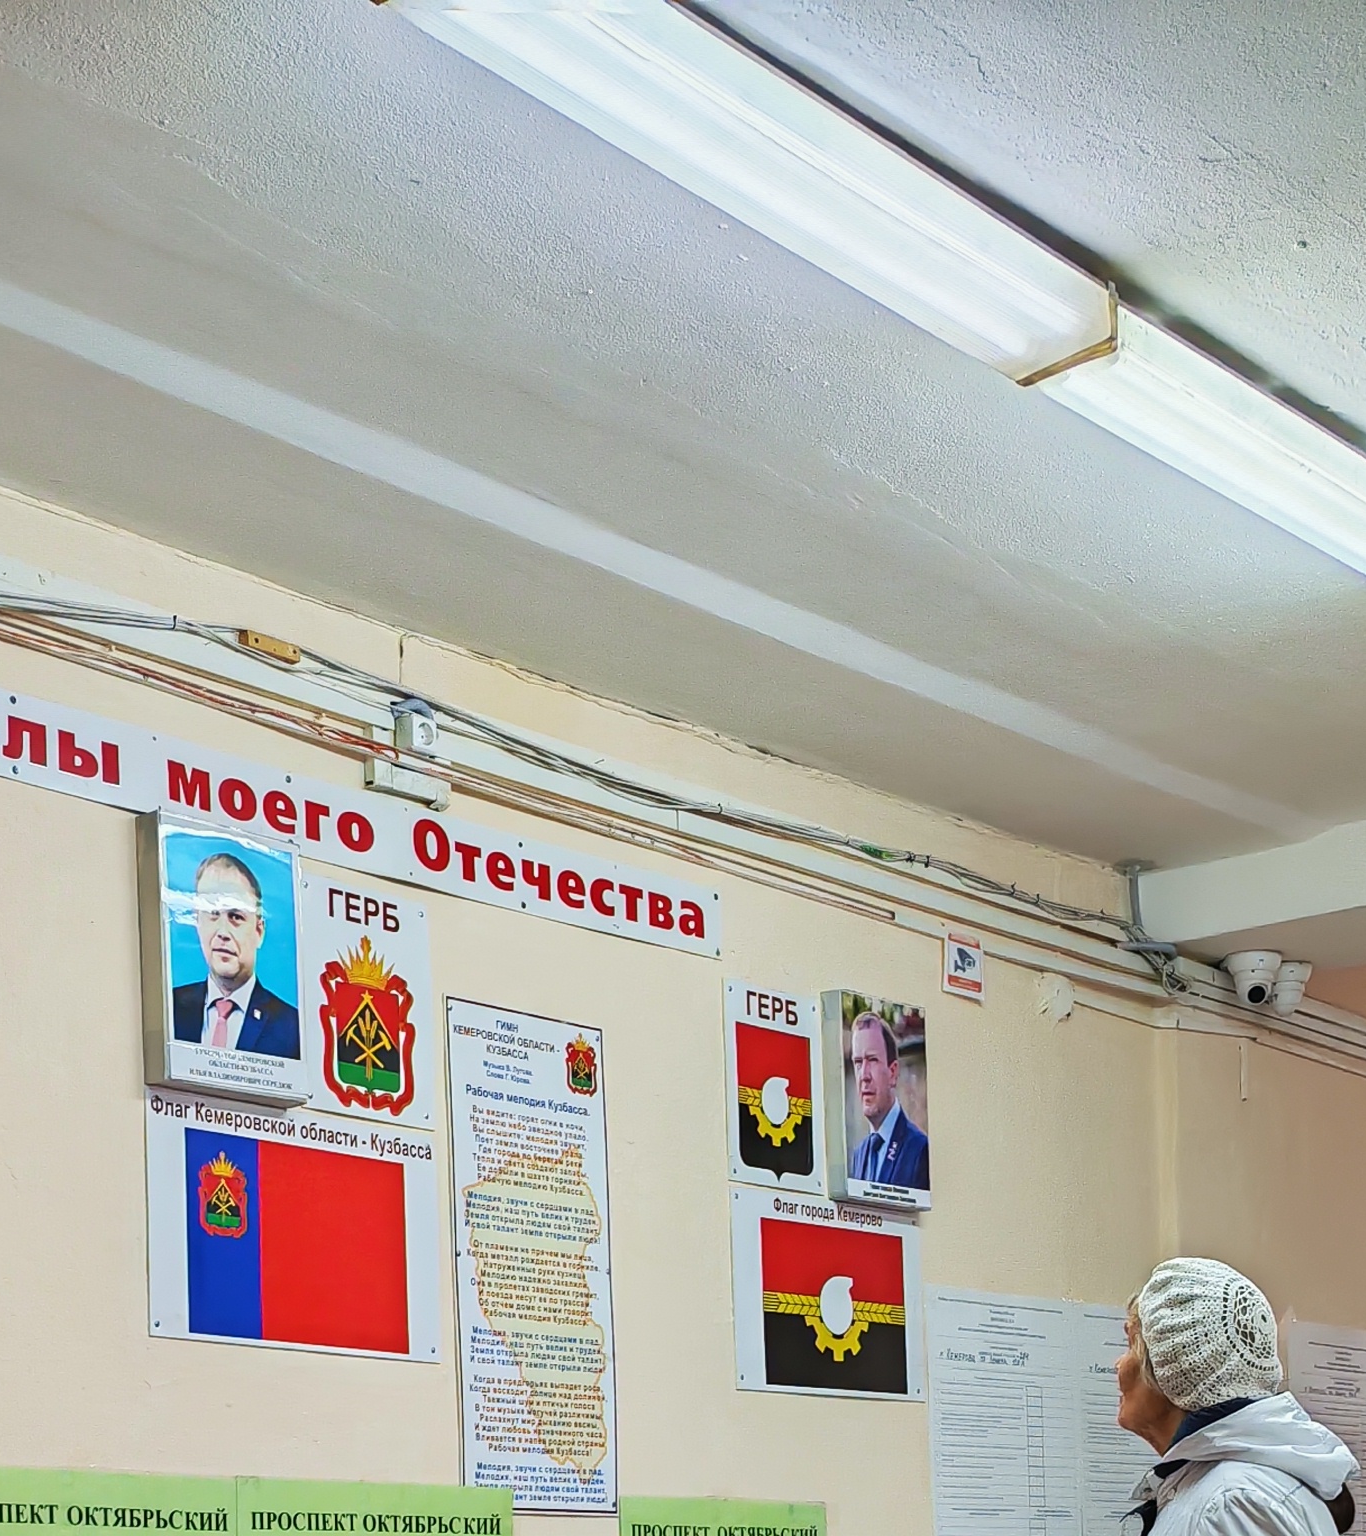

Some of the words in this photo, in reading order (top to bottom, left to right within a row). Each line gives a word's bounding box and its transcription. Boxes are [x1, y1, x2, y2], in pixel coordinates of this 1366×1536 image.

[167, 759, 375, 853] моего
[412, 819, 706, 939] Отечества
[328, 888, 400, 933] ГЕРБ
[745, 990, 799, 1027] ГЕРБ
[495, 1019, 519, 1033] ГИМН
[465, 1083, 504, 1101] Рабочая
[151, 1095, 190, 1119] Флаг
[195, 1102, 295, 1138] Кемеровской
[300, 1122, 358, 1148] области
[371, 1133, 432, 1160] Кузбасса
[773, 1197, 798, 1214] Флаг
[801, 1204, 835, 1221] города
[837, 1204, 883, 1227] Кемерово
[67, 1505, 228, 1532] ОКТЯБРЬСКИЙ
[251, 1511, 357, 1532] ПРОСПЕКТ
[363, 1513, 501, 1535] ОКТЯБРЬСКИЙ
